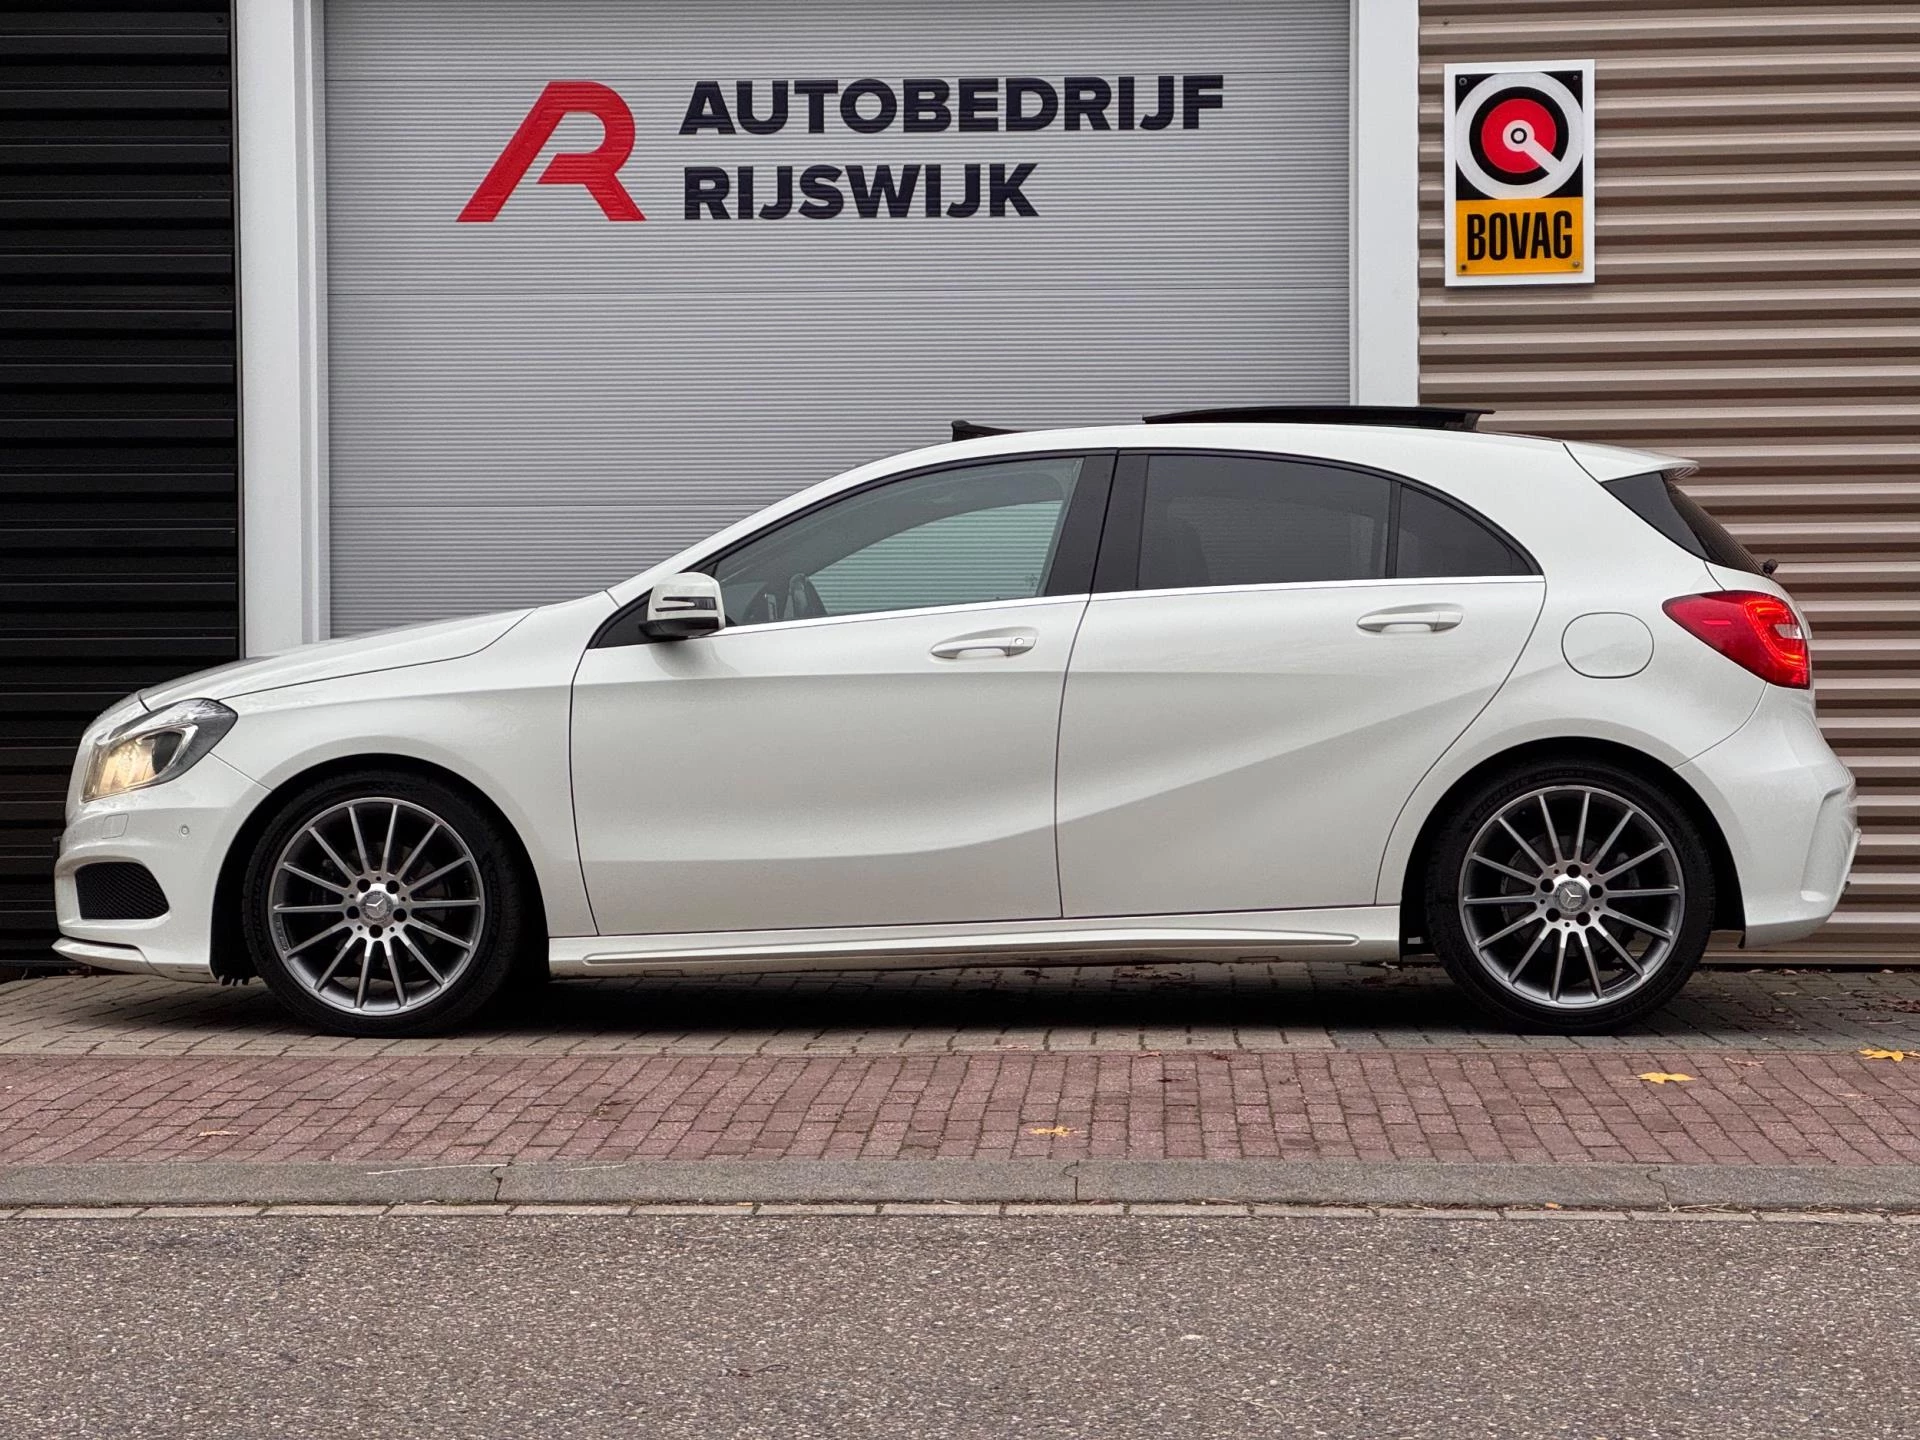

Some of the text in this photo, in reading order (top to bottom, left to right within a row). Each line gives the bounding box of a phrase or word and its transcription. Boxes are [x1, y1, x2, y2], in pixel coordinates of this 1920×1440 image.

[679, 76, 1225, 135] AUTOBEDRIJF
[684, 163, 1040, 220] RIJSWIJK
[1467, 211, 1573, 261] BOVAG
